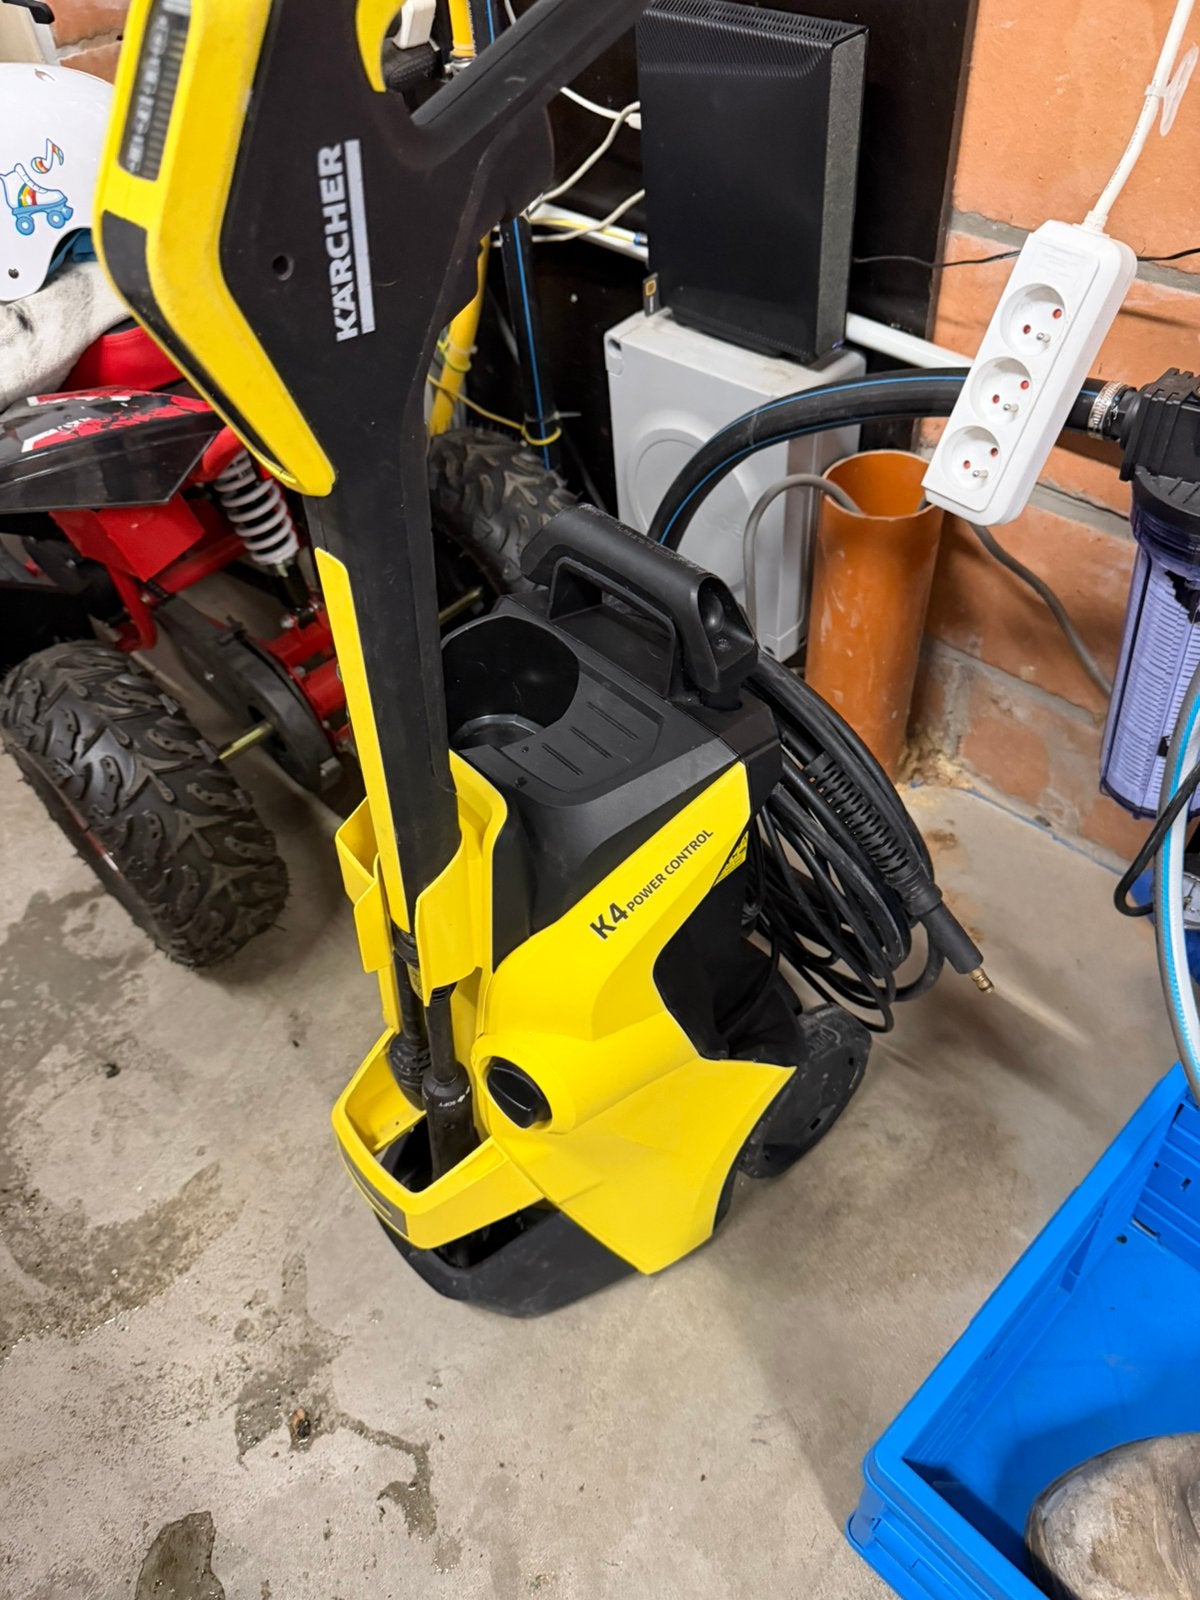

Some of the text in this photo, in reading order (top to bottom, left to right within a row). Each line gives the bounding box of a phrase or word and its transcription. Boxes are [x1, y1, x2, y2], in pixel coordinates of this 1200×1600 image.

[318, 143, 359, 342] KÄRCHER
[626, 872, 667, 912] POWER
[664, 829, 714, 876] CONTROL
